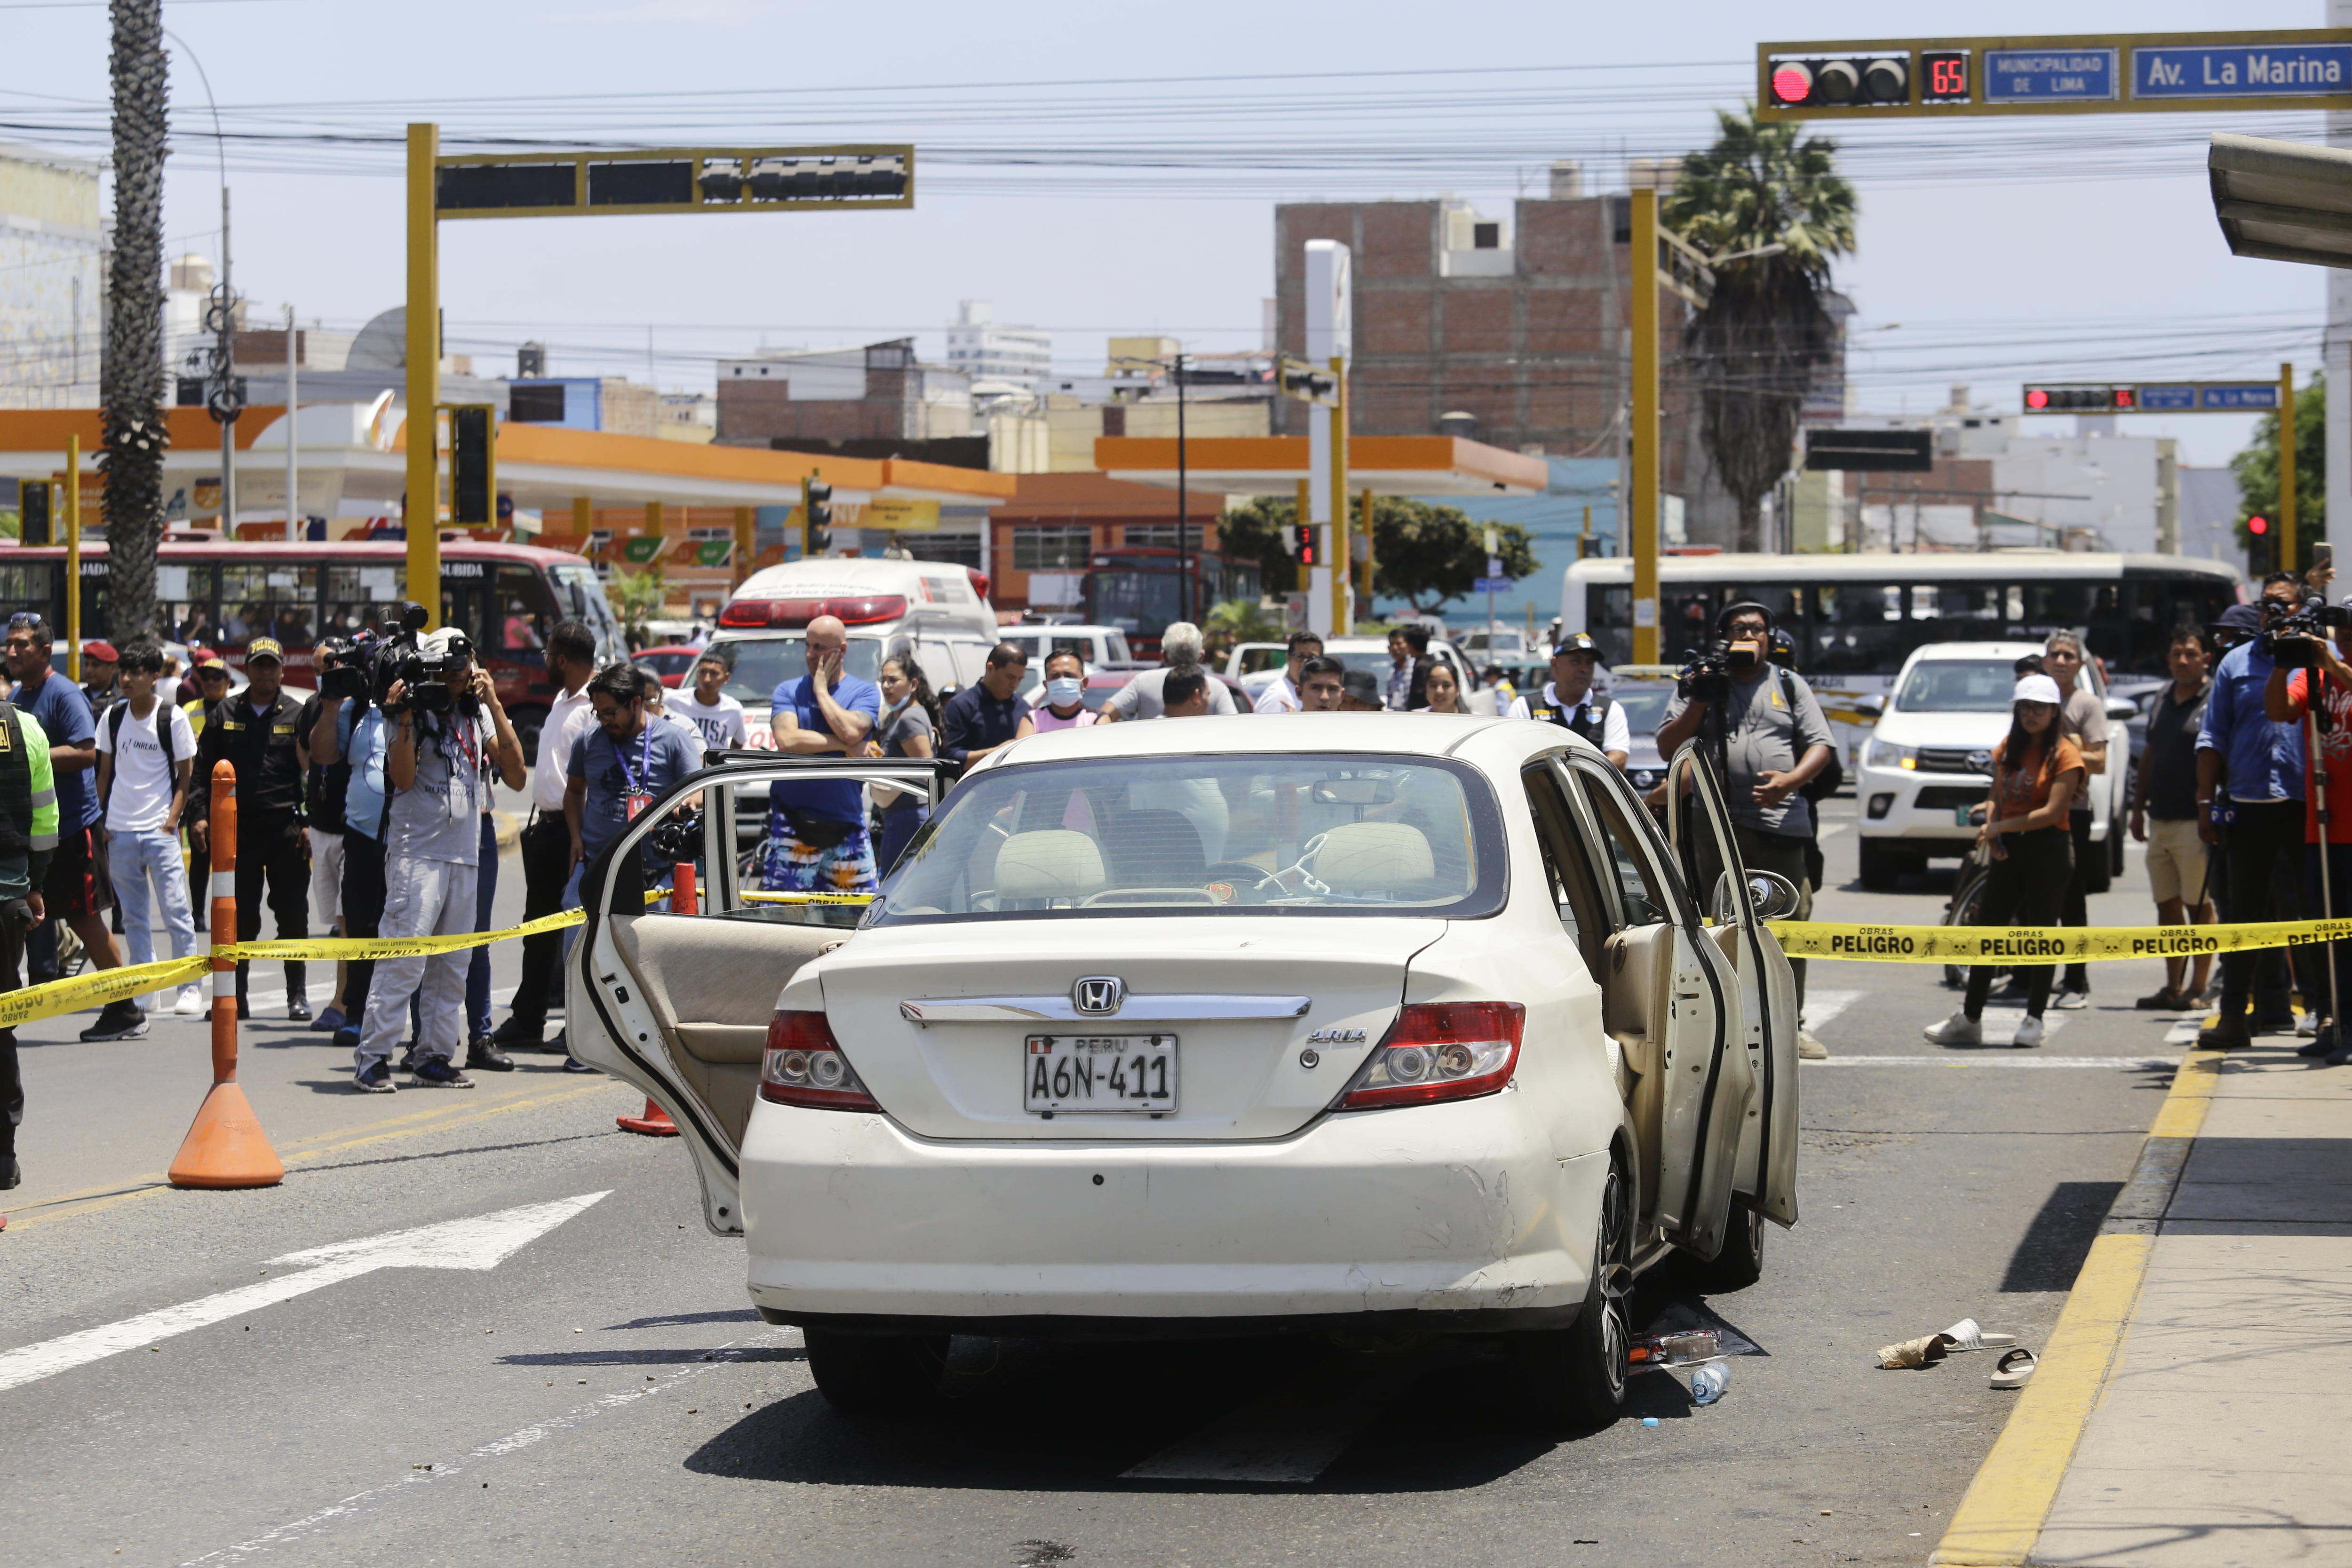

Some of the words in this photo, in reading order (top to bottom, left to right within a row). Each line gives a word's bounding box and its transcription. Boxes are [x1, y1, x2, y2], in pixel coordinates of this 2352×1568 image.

[1998, 57, 2103, 73] MUNICIPALIDAD
[2148, 56, 2185, 86] Av.
[2204, 56, 2237, 85] La
[2248, 55, 2341, 84] Marina
[1933, 60, 1963, 93] 65
[2013, 78, 2031, 92] DE
[2050, 78, 2085, 92] LIMA
[251, 639, 279, 654] POLICIA
[134, 740, 158, 751] UNREAD
[2315, 922, 2351, 931] OBRAS
[1832, 935, 1914, 954] PELIGRO
[1981, 939, 2065, 955] PELIGRO
[2133, 937, 2218, 954] PELIGRO
[1306, 1027, 1367, 1043] ARIA
[1075, 1039, 1128, 1054] PERU
[1032, 1056, 1169, 1098] A6N-411
